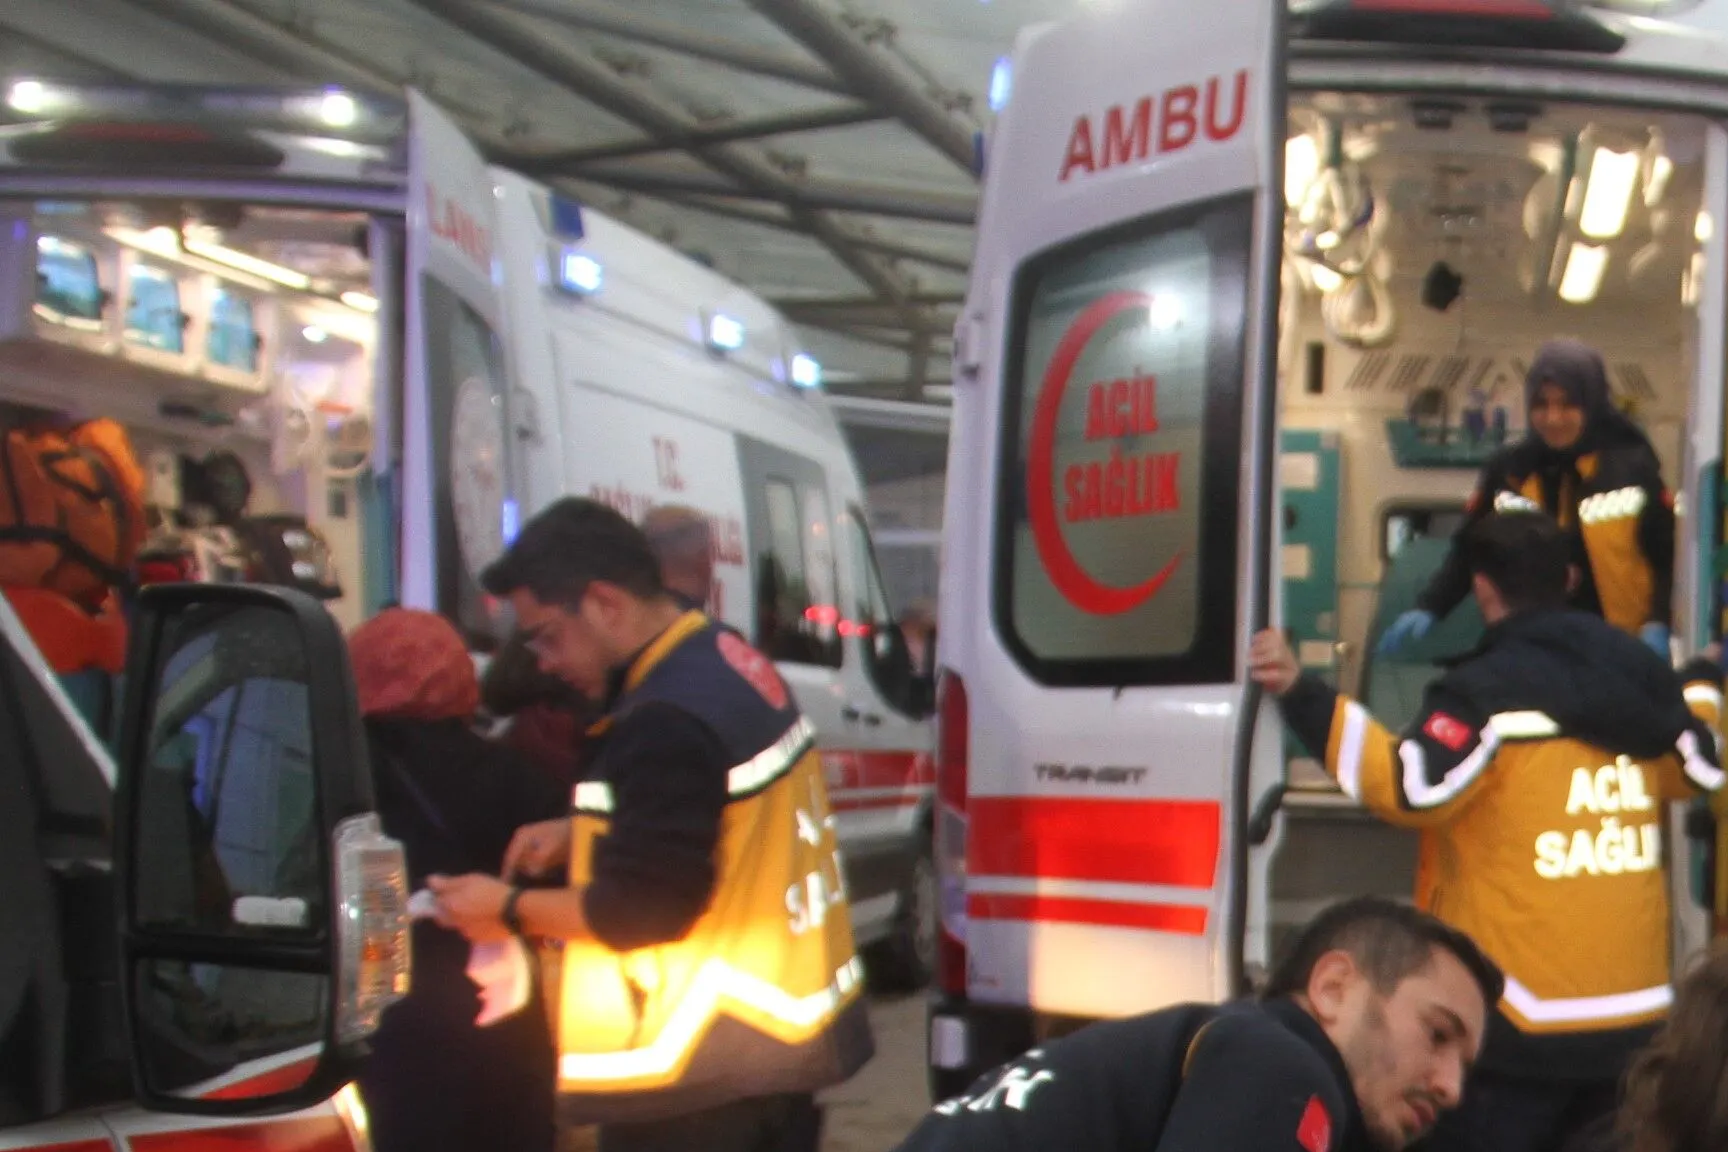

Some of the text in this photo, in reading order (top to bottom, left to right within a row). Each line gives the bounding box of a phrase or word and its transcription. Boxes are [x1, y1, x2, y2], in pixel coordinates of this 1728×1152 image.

[1057, 67, 1249, 182] AMBU
[1063, 445, 1182, 523] SAĞLIK
[1565, 754, 1653, 815] ACİL
